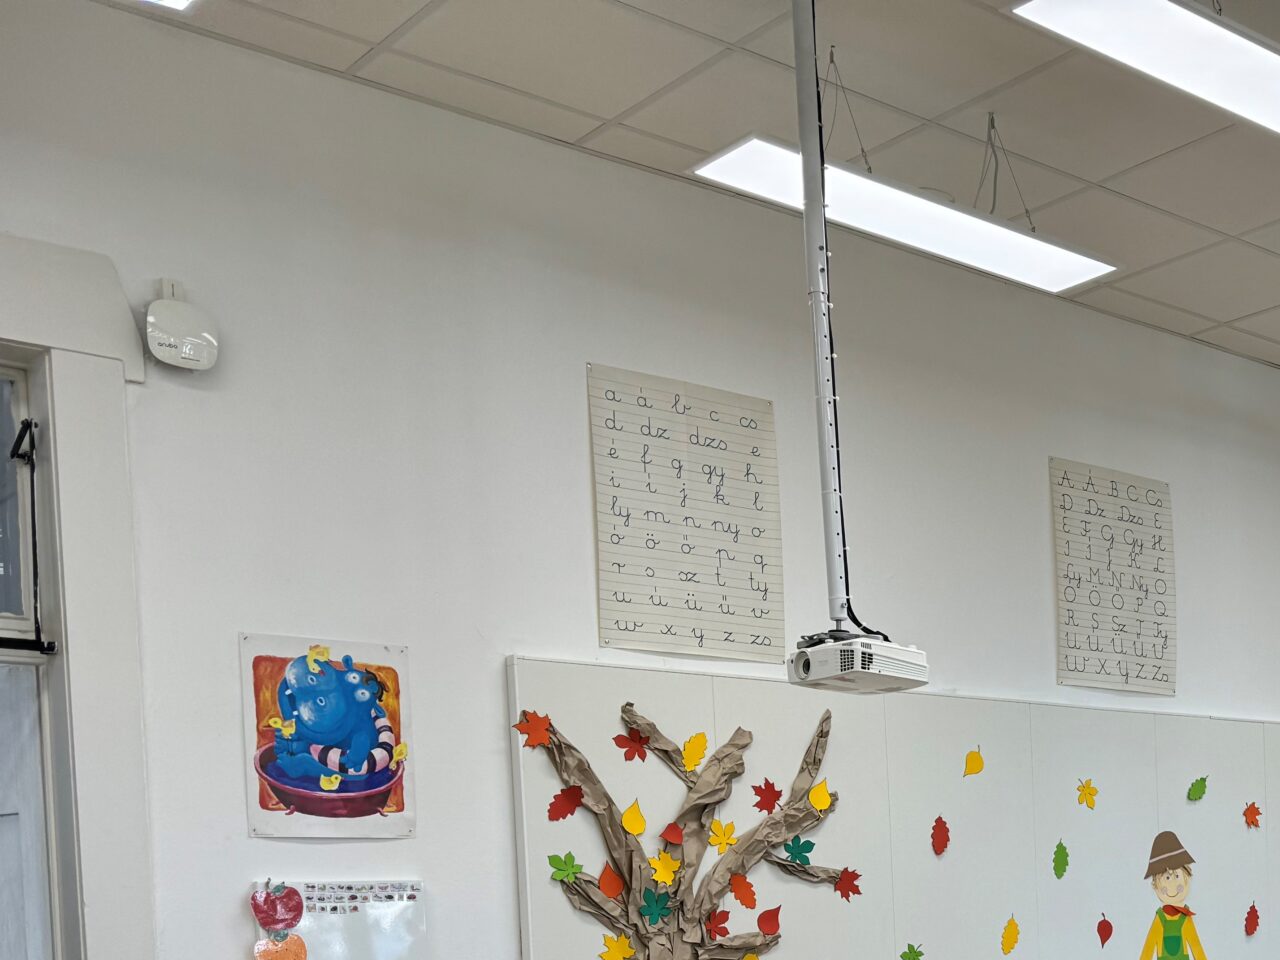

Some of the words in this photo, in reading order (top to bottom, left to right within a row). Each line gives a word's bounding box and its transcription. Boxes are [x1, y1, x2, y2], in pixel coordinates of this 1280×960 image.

[605, 389, 622, 403] a
[637, 388, 652, 409] á
[672, 394, 691, 414] b
[710, 410, 720, 422] c
[740, 416, 758, 430] cs
[605, 410, 623, 431] d
[641, 417, 670, 440] dz
[690, 426, 728, 451] dzs
[751, 446, 760, 457] e
[609, 438, 619, 459] é
[641, 445, 652, 472] f
[671, 459, 683, 479] g
[702, 464, 726, 485] gy
[744, 464, 762, 484] h
[610, 471, 620, 488] i
[646, 473, 657, 493] í
[680, 483, 687, 507] j
[714, 485, 730, 506] k
[753, 492, 763, 511] l
[1058, 470, 1074, 489] A
[1083, 470, 1099, 493] Á
[1108, 481, 1119, 497] B
[1127, 485, 1139, 502] C
[1146, 490, 1162, 507] Cs
[611, 496, 631, 526] ly
[644, 509, 670, 523] m
[683, 516, 701, 528] n
[712, 519, 740, 542] ny
[752, 527, 765, 538] o
[1060, 494, 1073, 511] D
[1085, 499, 1106, 518] Dz
[1117, 506, 1144, 526] Dzs
[1154, 513, 1161, 529] E
[610, 525, 624, 544] ó
[646, 533, 660, 550] ö
[681, 535, 695, 554] ő
[716, 548, 735, 568] p
[754, 554, 768, 573] q
[1101, 525, 1114, 550] G
[1123, 529, 1144, 555] Gy
[1152, 535, 1166, 551] H
[1128, 552, 1141, 569] K
[1154, 557, 1165, 573] L
[716, 567, 726, 586] t
[748, 572, 768, 600] ty
[1064, 564, 1082, 588] Ly
[1086, 567, 1103, 585] M
[1109, 571, 1124, 588] N
[1130, 574, 1149, 599] Ny
[1155, 579, 1166, 594] O
[613, 590, 632, 603] u
[650, 586, 668, 607] ú
[685, 593, 702, 612] ü
[719, 596, 736, 616] ű
[752, 608, 770, 618] v
[1089, 586, 1100, 606] Ö
[1134, 597, 1143, 612] P
[1154, 601, 1168, 617] Q
[615, 620, 643, 632] w
[660, 624, 677, 636] x
[692, 628, 704, 647] y
[724, 631, 734, 642] z
[750, 635, 772, 646] zs
[1065, 609, 1079, 626] R
[1112, 616, 1127, 633] Sz
[1154, 622, 1168, 645] Ty
[1065, 632, 1081, 649] U
[1111, 633, 1127, 654] Ü
[1152, 643, 1168, 659] V
[1065, 655, 1089, 672] W
[1095, 659, 1111, 675] X
[1117, 660, 1129, 684] Y
[1135, 663, 1147, 679] Z
[1152, 666, 1168, 682] Zs
